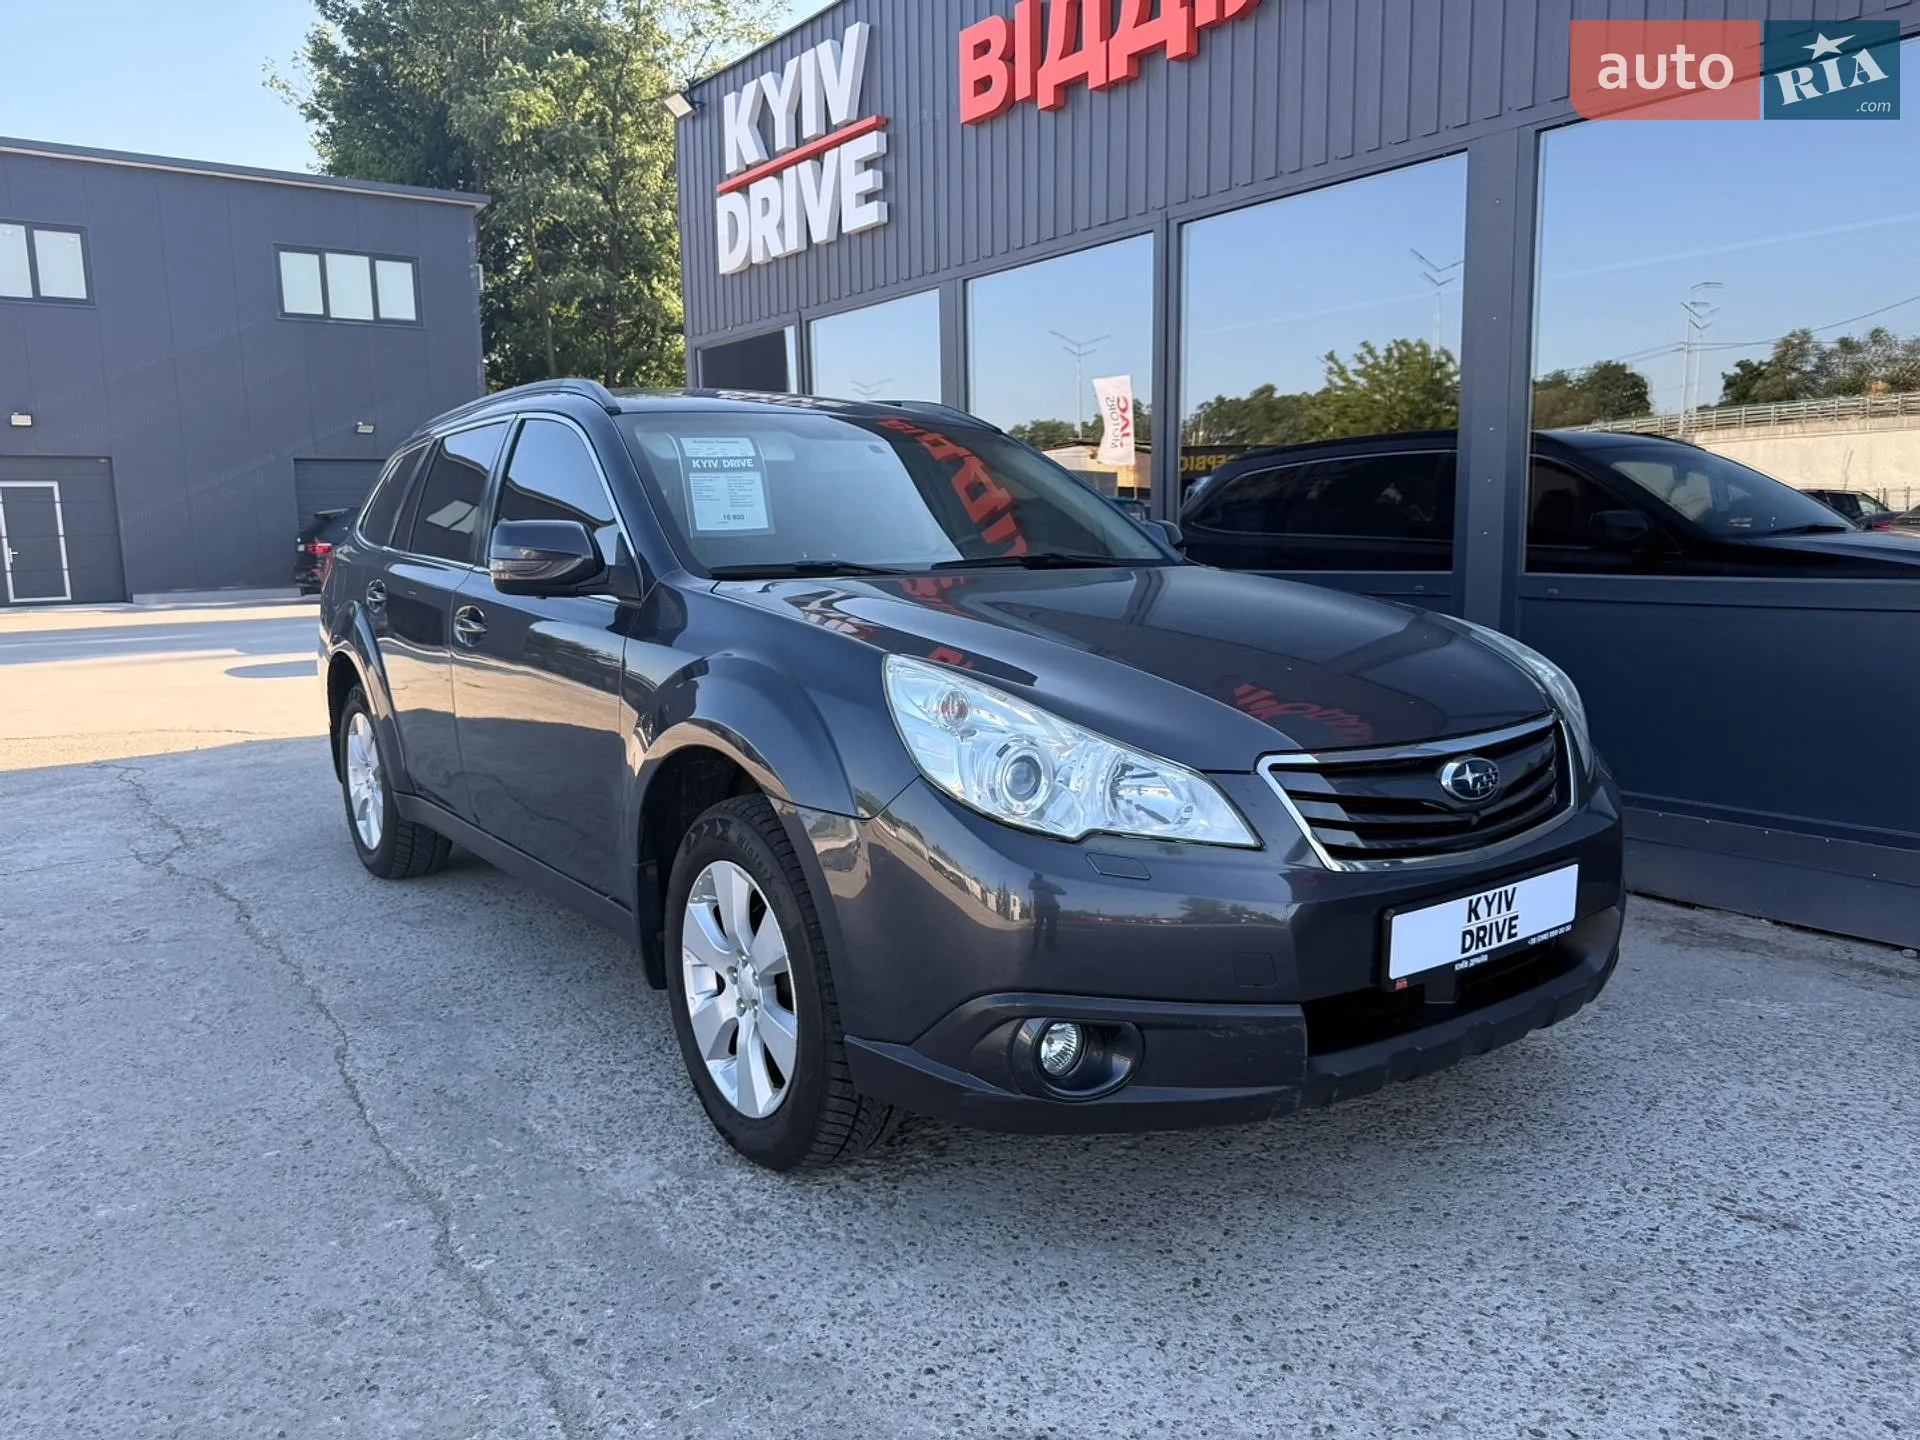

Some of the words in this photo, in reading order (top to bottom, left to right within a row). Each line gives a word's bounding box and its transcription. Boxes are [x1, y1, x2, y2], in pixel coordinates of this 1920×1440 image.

[722, 21, 871, 176] KYIV
[716, 130, 889, 275] DRIVE
[692, 459, 718, 469] KYIV
[722, 458, 754, 469] DRIVE
[1466, 886, 1518, 924] KYIV
[1460, 914, 1520, 955] DRIVE
